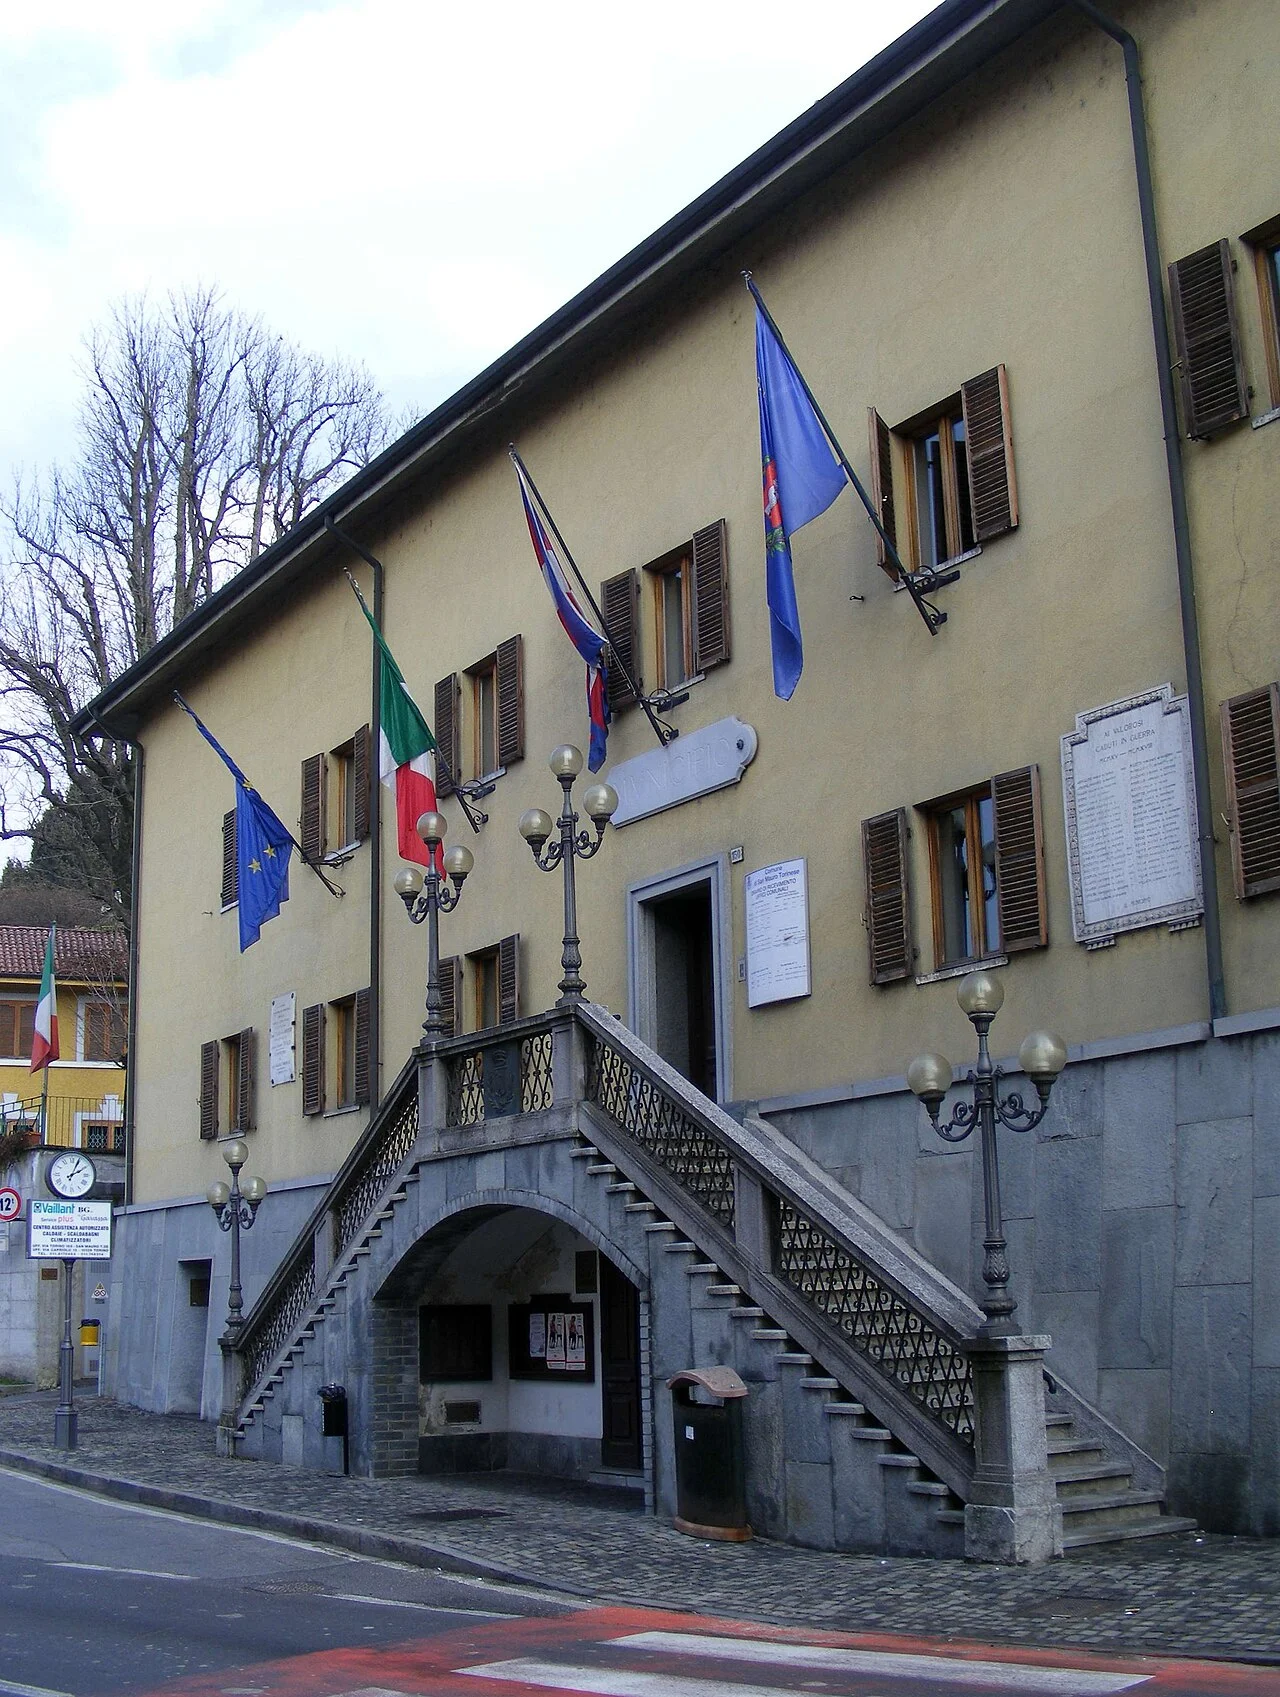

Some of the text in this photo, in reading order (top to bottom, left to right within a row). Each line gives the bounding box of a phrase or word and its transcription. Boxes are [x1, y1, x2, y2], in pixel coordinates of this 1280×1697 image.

[1129, 728, 1155, 742] GUERRA
[42, 1202, 75, 1214] Vaillant
[58, 1215, 74, 1223] plus
